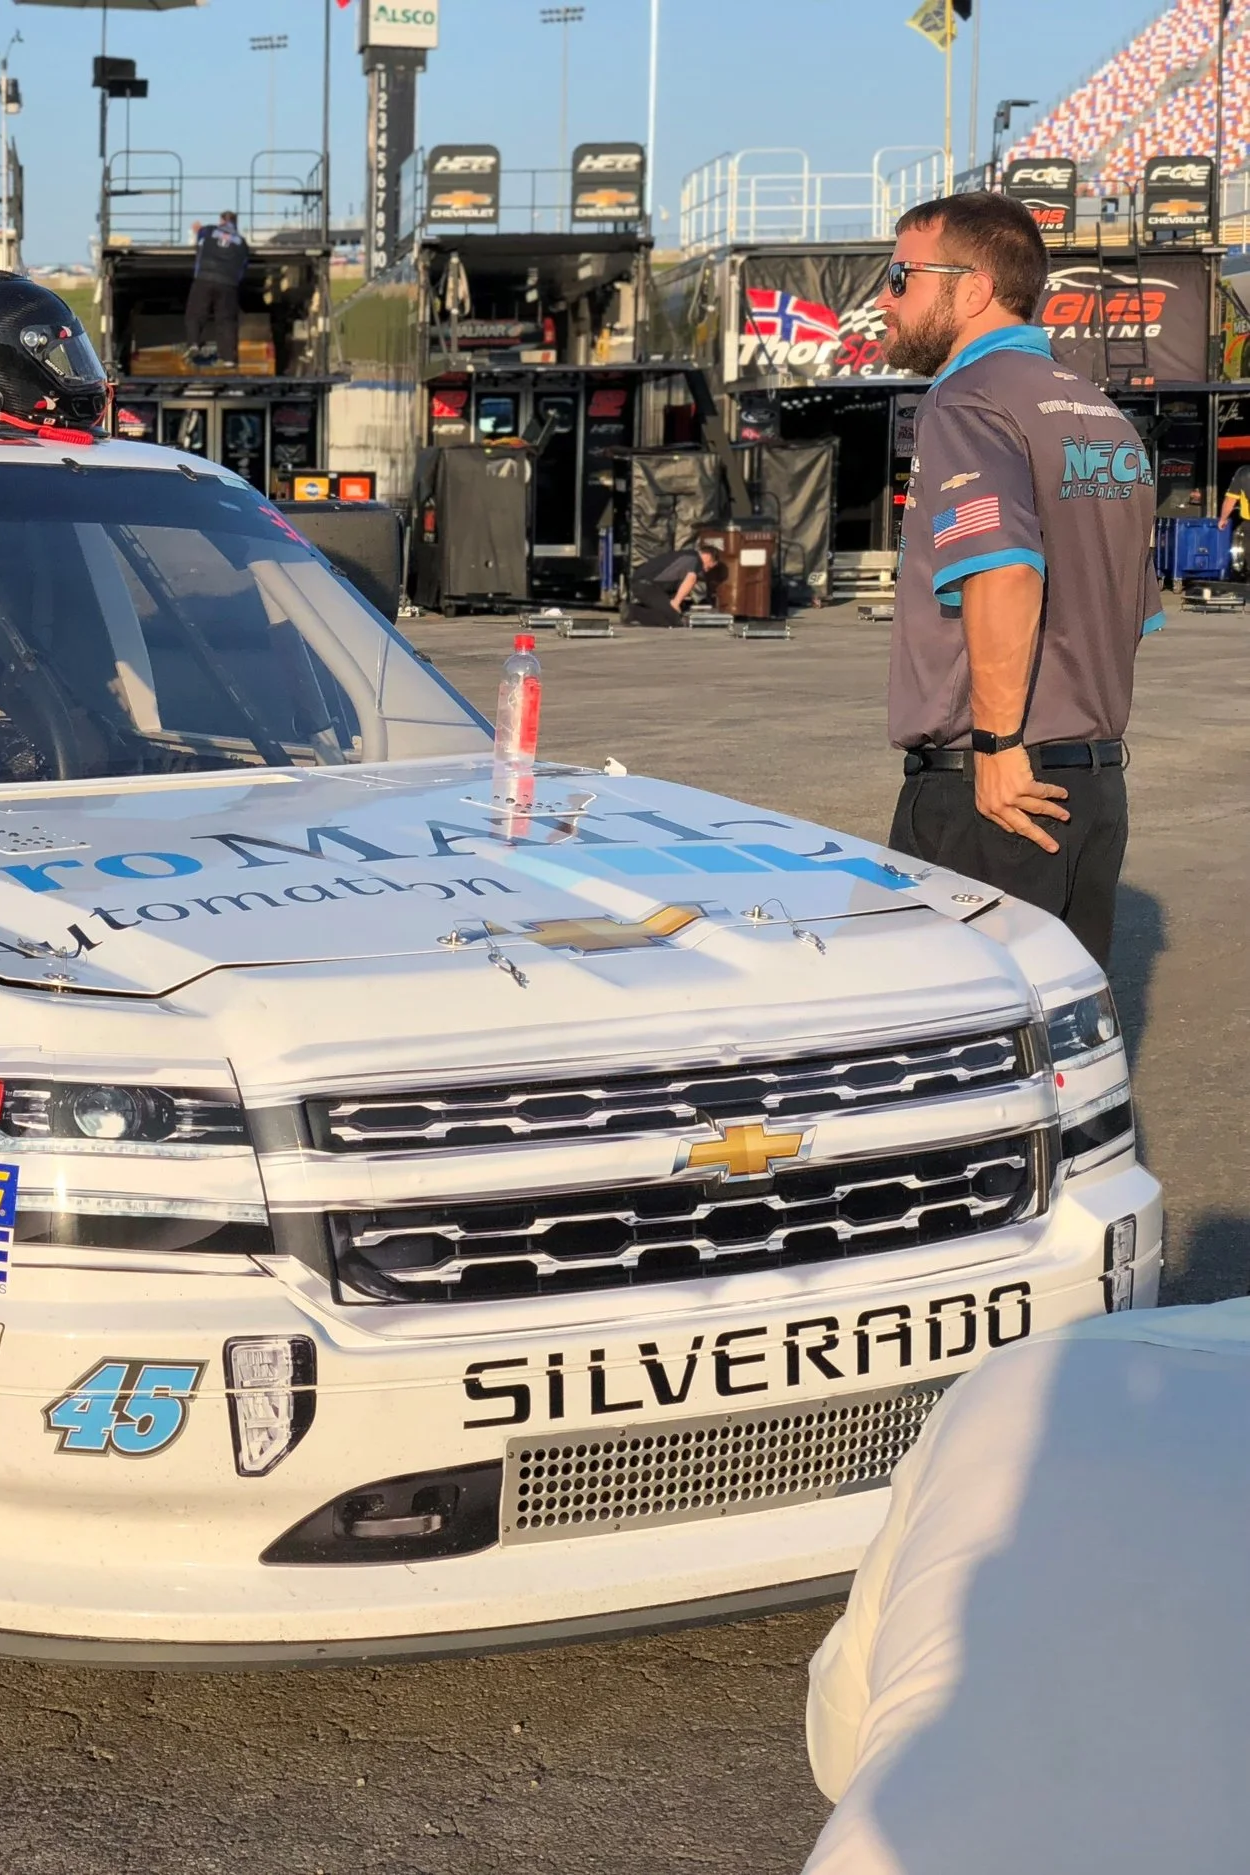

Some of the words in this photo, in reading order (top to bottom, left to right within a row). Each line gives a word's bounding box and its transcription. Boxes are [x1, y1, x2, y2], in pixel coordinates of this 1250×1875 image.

[374, 6, 434, 25] ALSCO
[379, 72, 387, 88] 1
[378, 93, 387, 109] 2
[378, 114, 387, 129] 3
[378, 133, 387, 148] 4
[378, 153, 387, 169] 5
[377, 174, 386, 189] 6
[377, 192, 386, 208] 7
[376, 211, 386, 227] 8
[430, 208, 494, 217] CHEVROLET
[575, 207, 639, 217] CHEVROLET
[1031, 209, 1066, 224] MS
[1148, 215, 1210, 225] CHEVROLET
[376, 232, 385, 247] 9
[1041, 291, 1167, 326] GMS
[462, 1281, 1031, 1430] SILVERADO
[40, 1356, 210, 1460] 45
